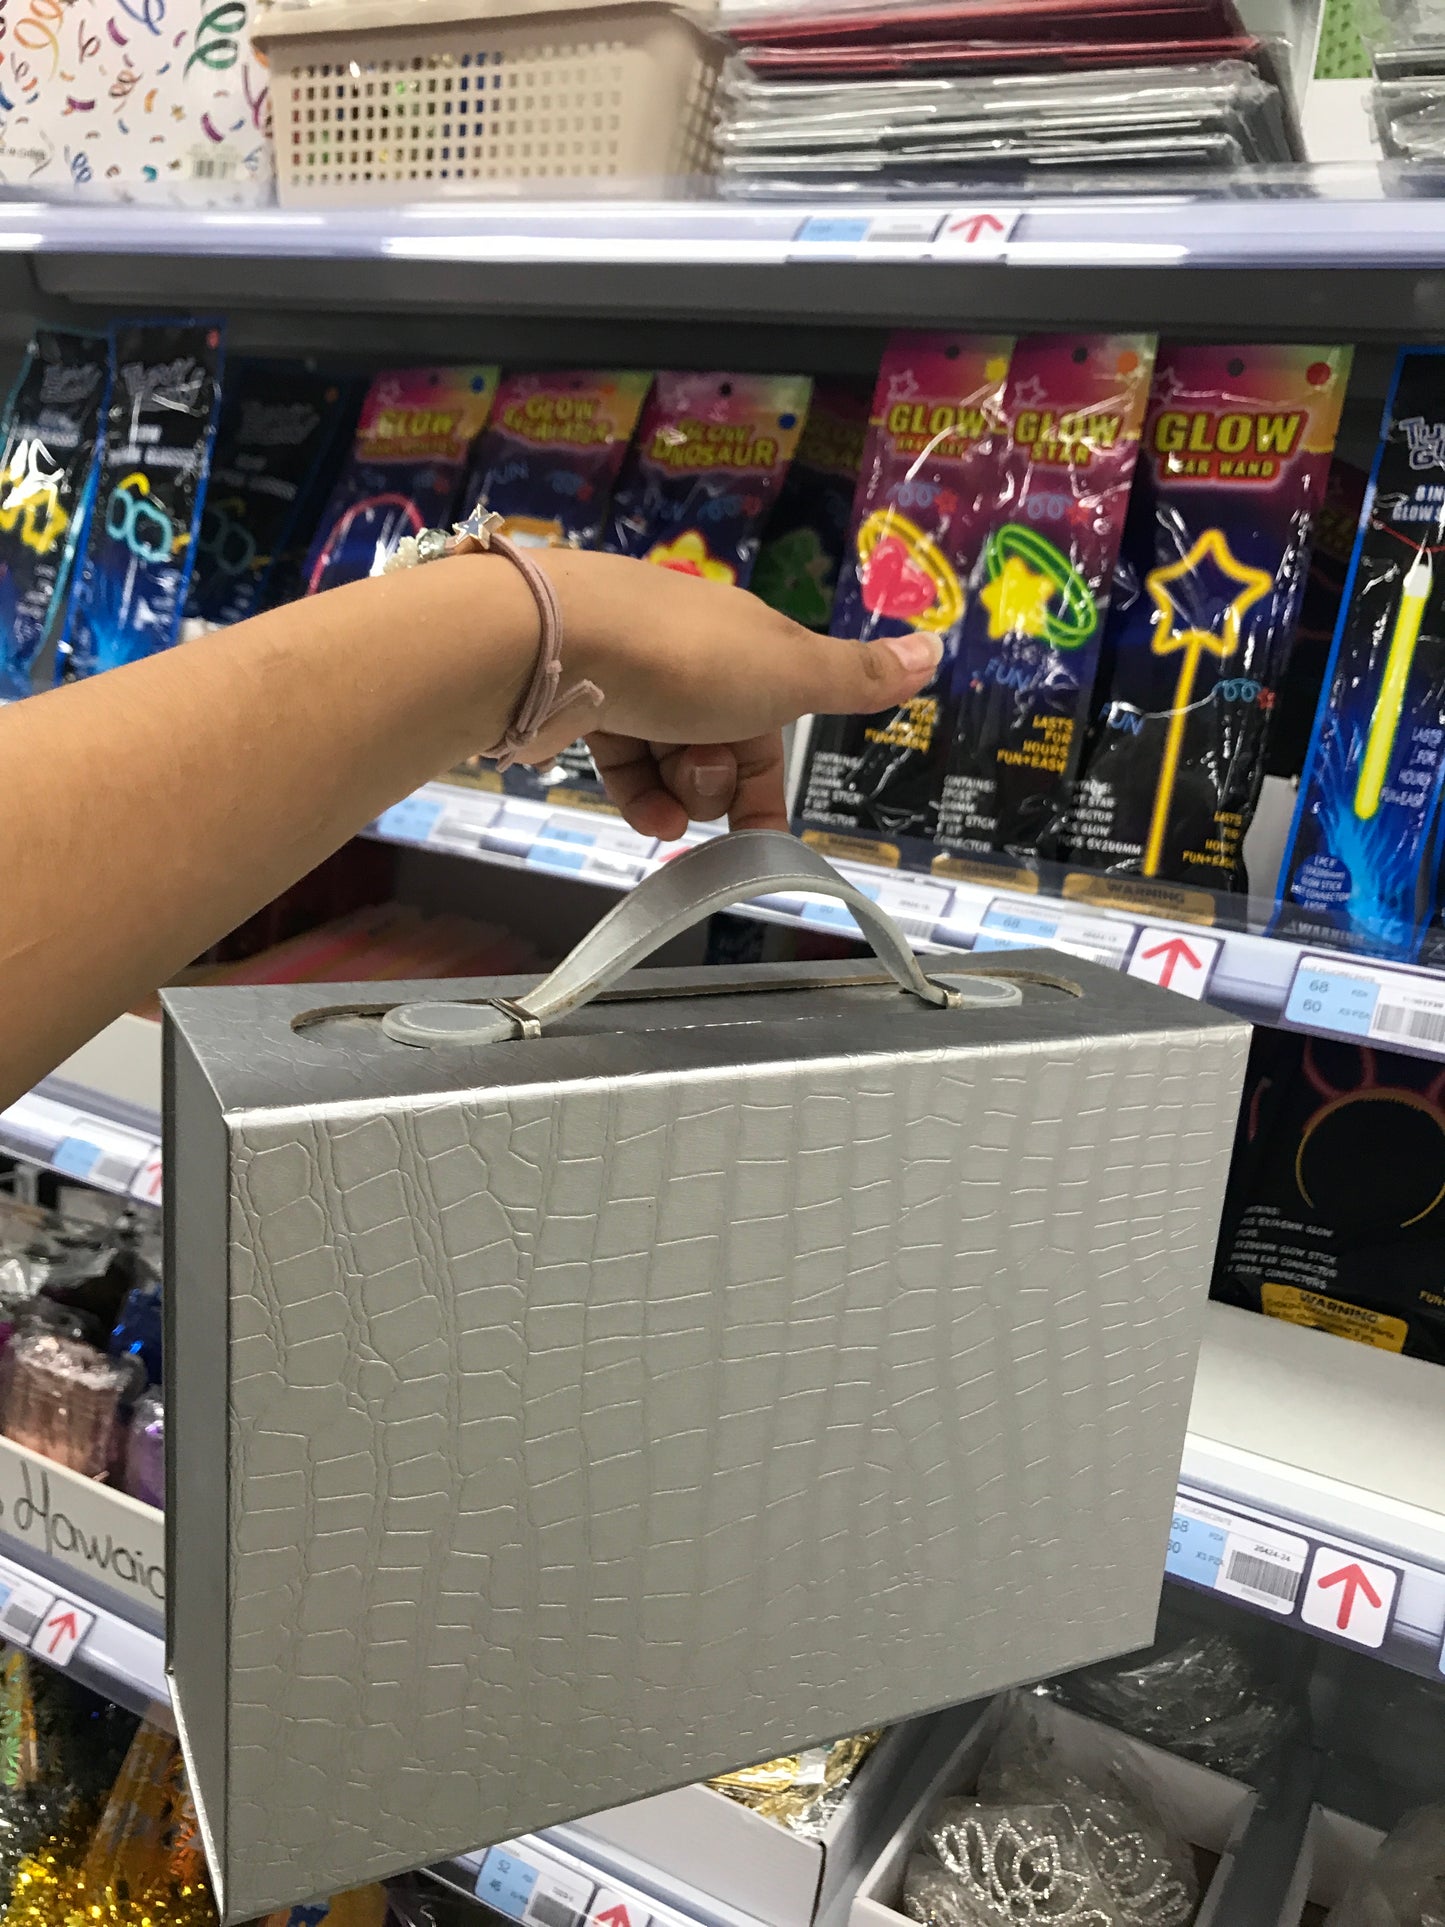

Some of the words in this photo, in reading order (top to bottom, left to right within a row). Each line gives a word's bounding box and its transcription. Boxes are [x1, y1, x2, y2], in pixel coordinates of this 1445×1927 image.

[887, 403, 987, 440] GLOW
[1015, 410, 1121, 448] GLOW
[1155, 412, 1301, 454] GLOW
[1163, 458, 1210, 475] AR
[1219, 459, 1274, 476] WAND
[985, 656, 1032, 690] FUN
[1033, 714, 1074, 732] LASTS
[1023, 740, 1068, 759] HOURS
[1309, 978, 1329, 994] 68
[1302, 998, 1322, 1014] 60
[1299, 1290, 1379, 1325] WARNING
